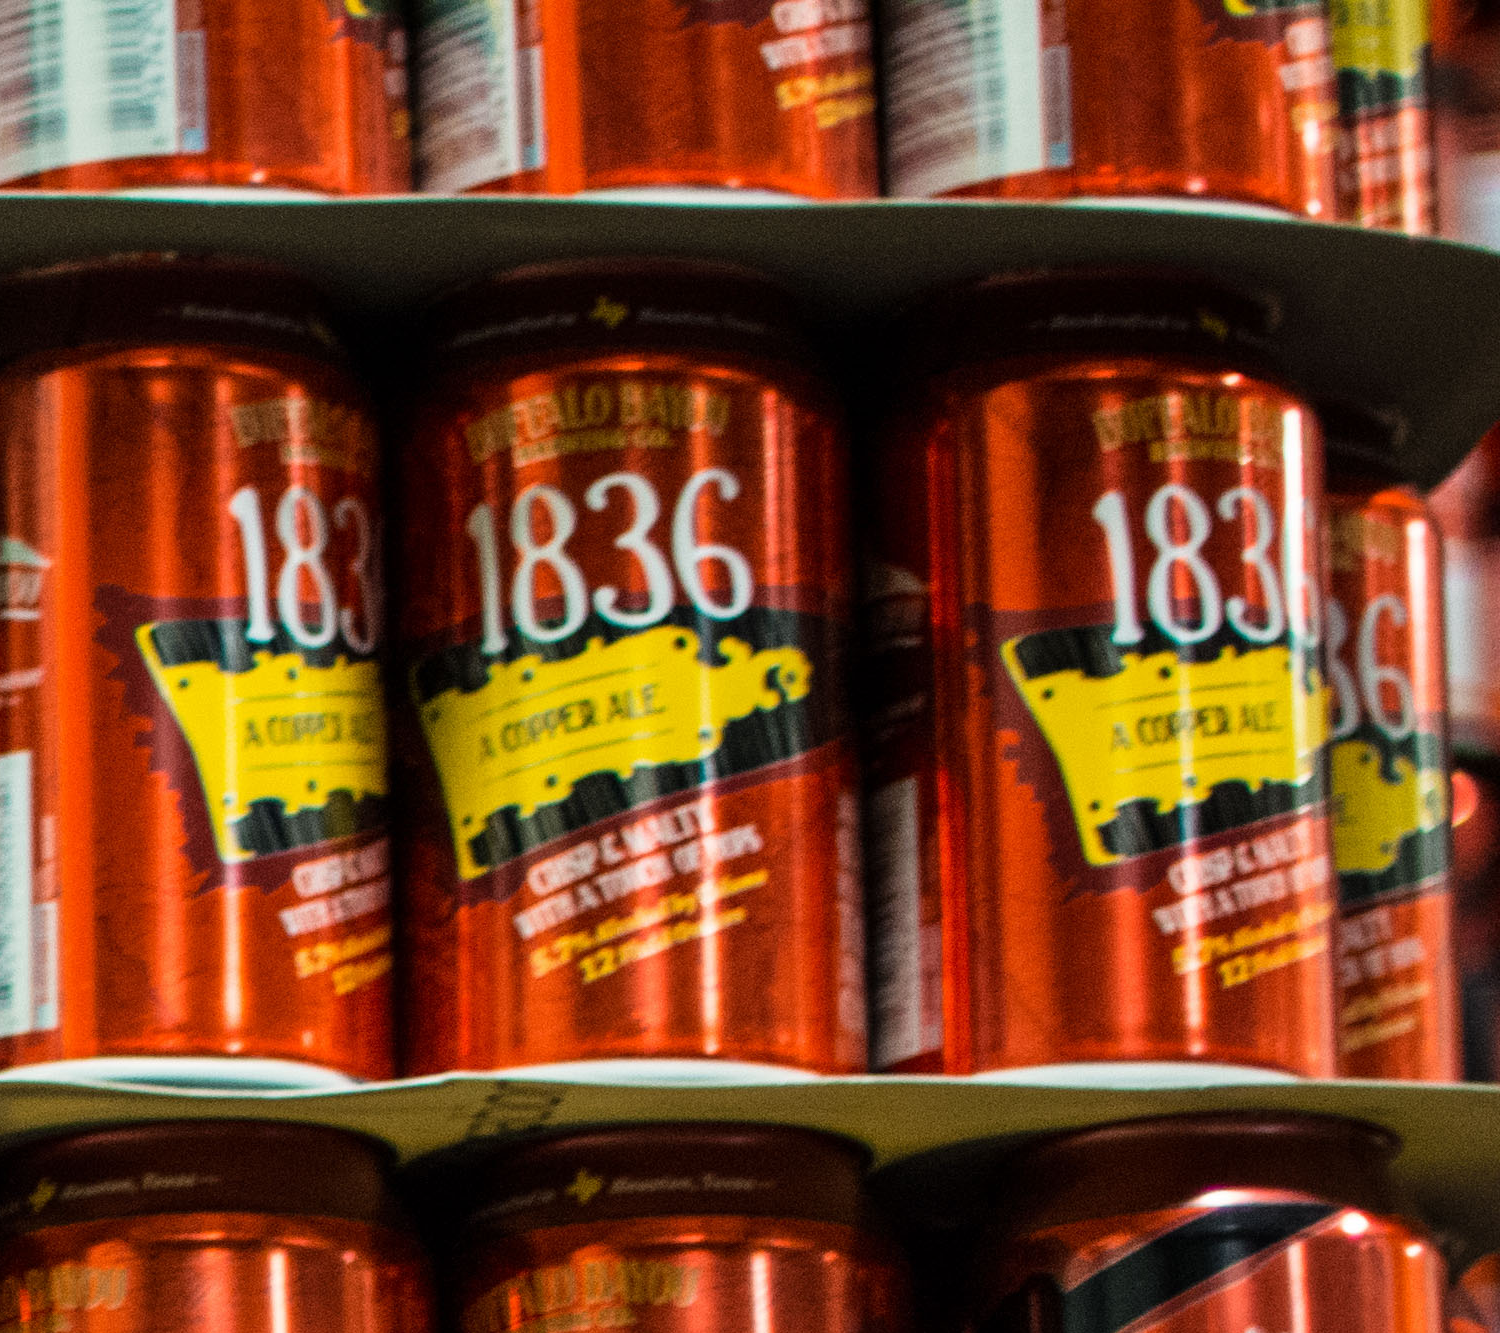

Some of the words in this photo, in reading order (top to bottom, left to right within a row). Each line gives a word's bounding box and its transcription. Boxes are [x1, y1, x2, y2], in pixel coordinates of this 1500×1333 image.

[229, 485, 383, 655] 183
[469, 469, 752, 656] 1836
[1093, 484, 1320, 645] 183
[501, 699, 598, 754] COPPER
[604, 684, 665, 725] ALE
[1137, 707, 1232, 744] COPPER
[1238, 701, 1282, 735] ALE
